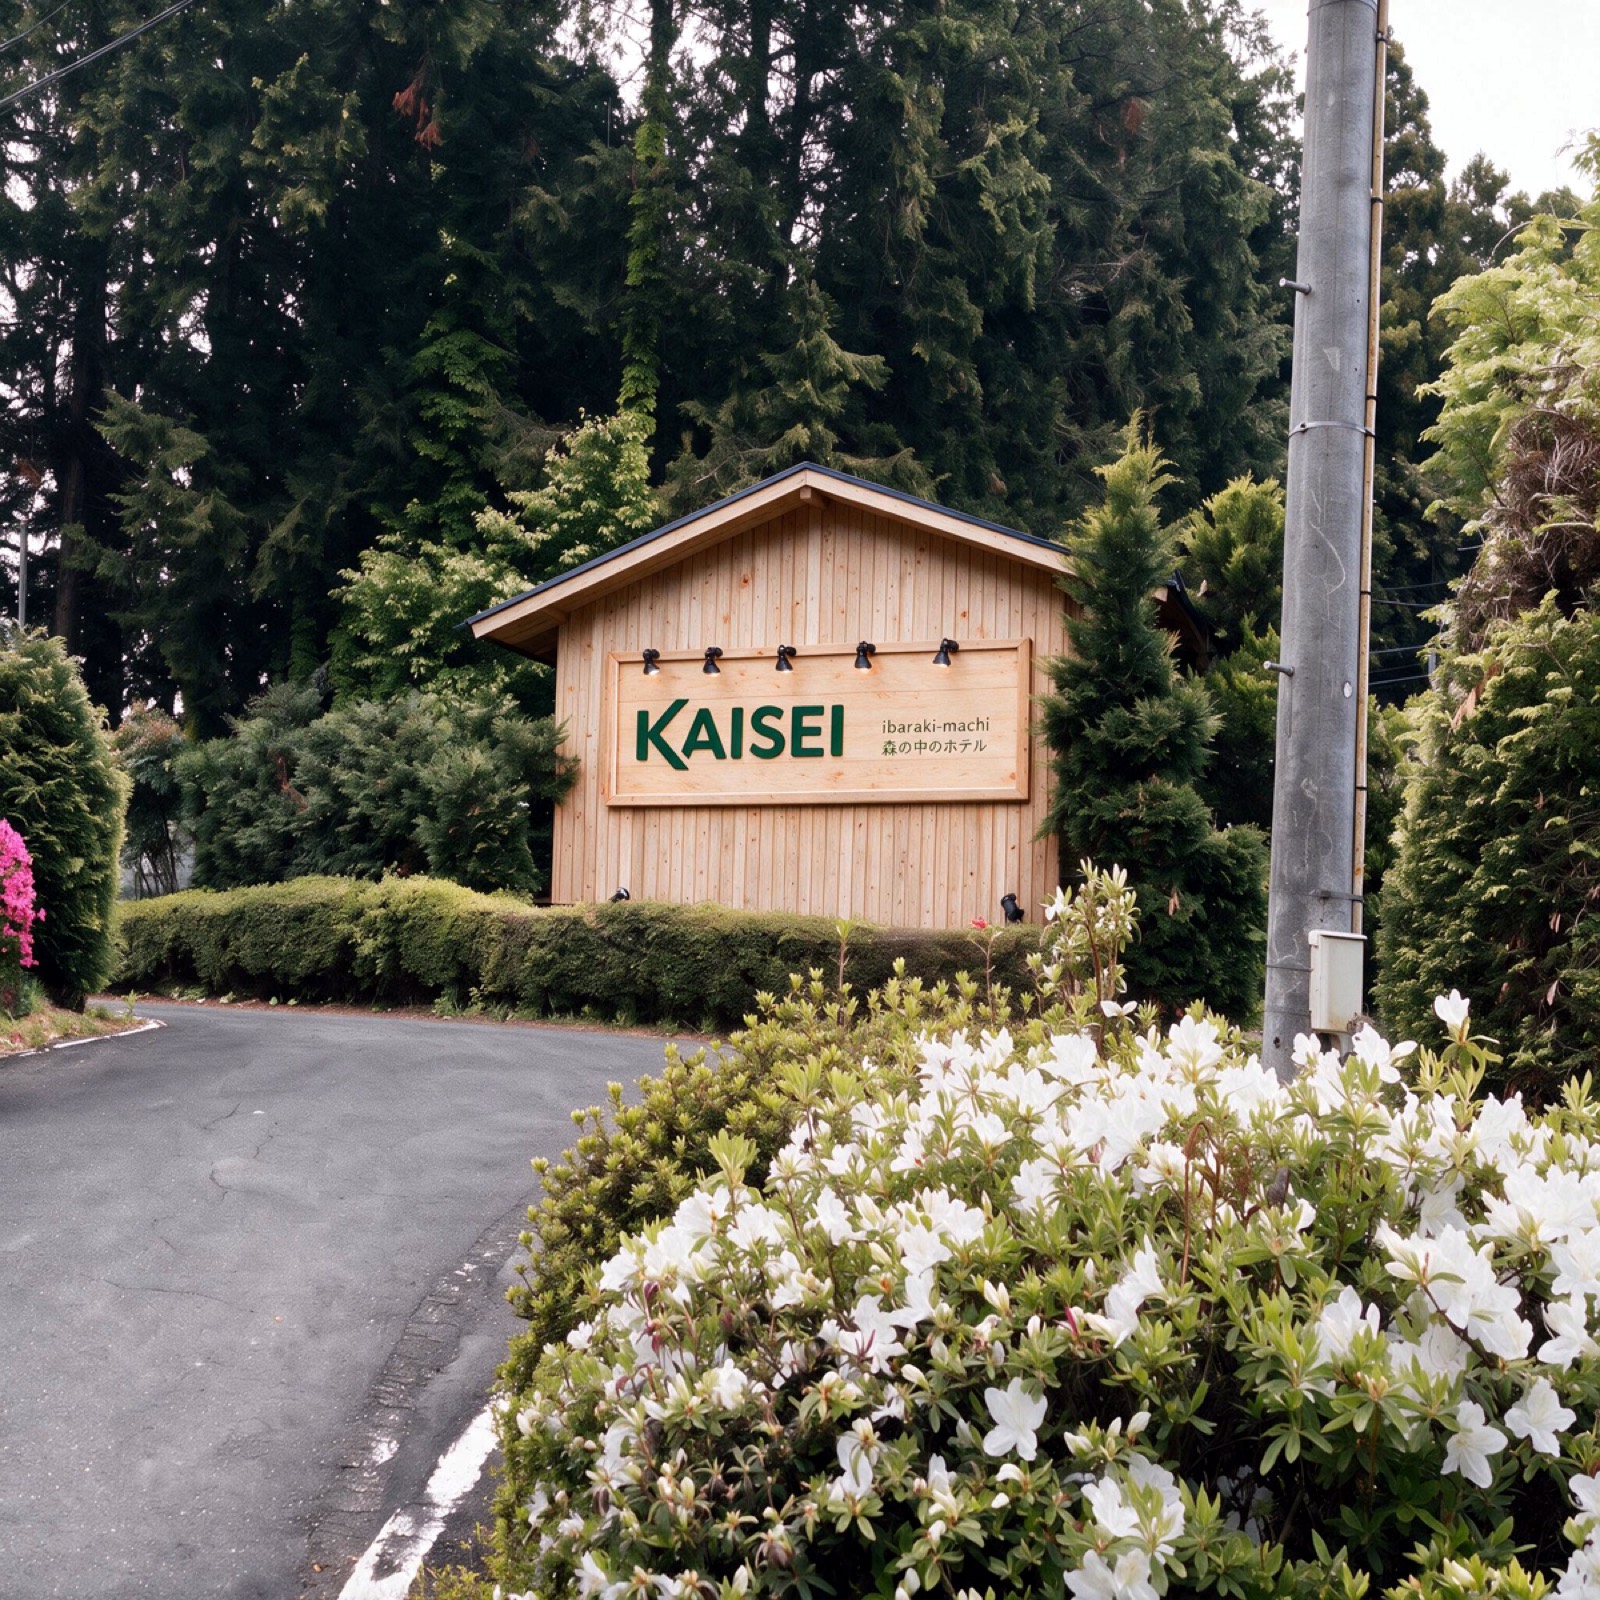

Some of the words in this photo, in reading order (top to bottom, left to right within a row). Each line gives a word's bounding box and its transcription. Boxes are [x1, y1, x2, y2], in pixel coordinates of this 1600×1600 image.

[882, 717, 990, 733] ibaraki-machi
[636, 699, 844, 771] KAISEI
[881, 739, 988, 756] 森の中のホテル
